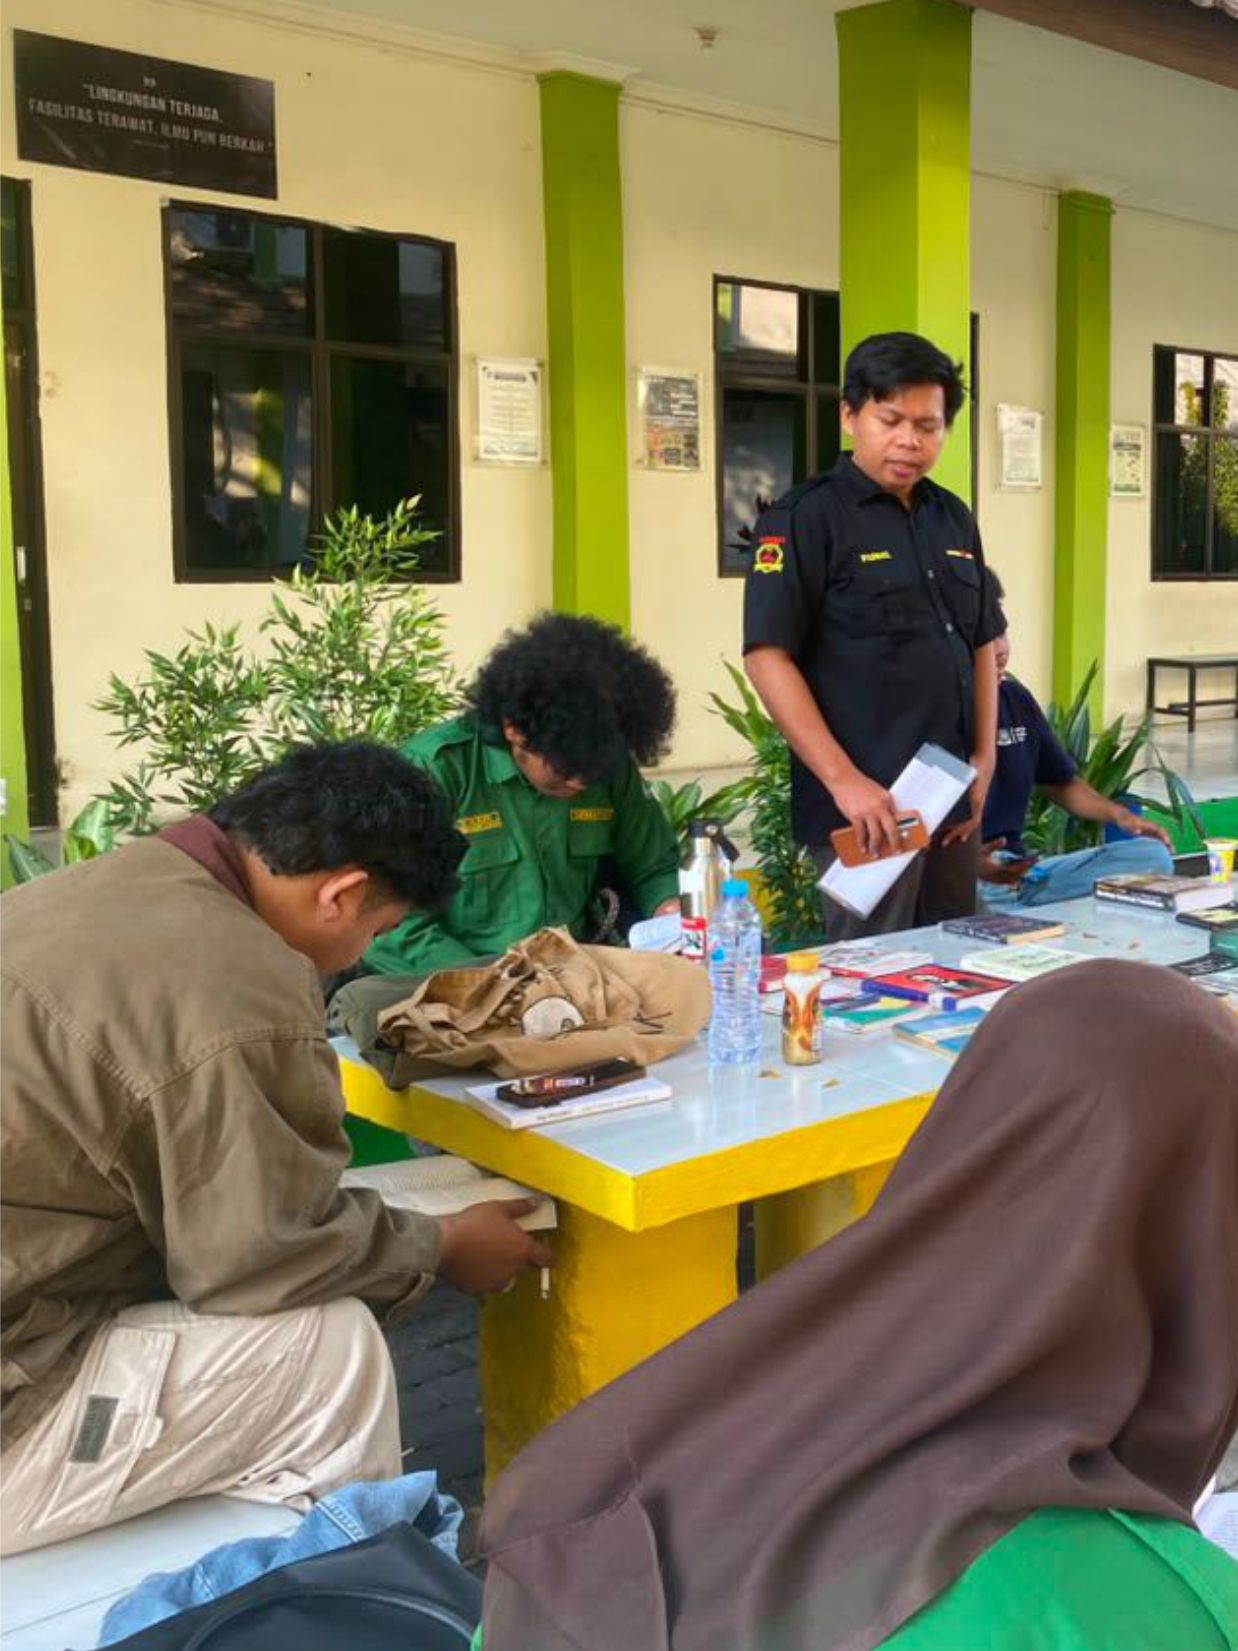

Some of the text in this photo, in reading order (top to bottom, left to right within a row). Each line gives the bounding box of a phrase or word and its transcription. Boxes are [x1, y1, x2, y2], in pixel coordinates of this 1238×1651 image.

[28, 97, 93, 123] FASILITAS
[160, 121, 190, 141] ILMU
[193, 128, 217, 145] PUN
